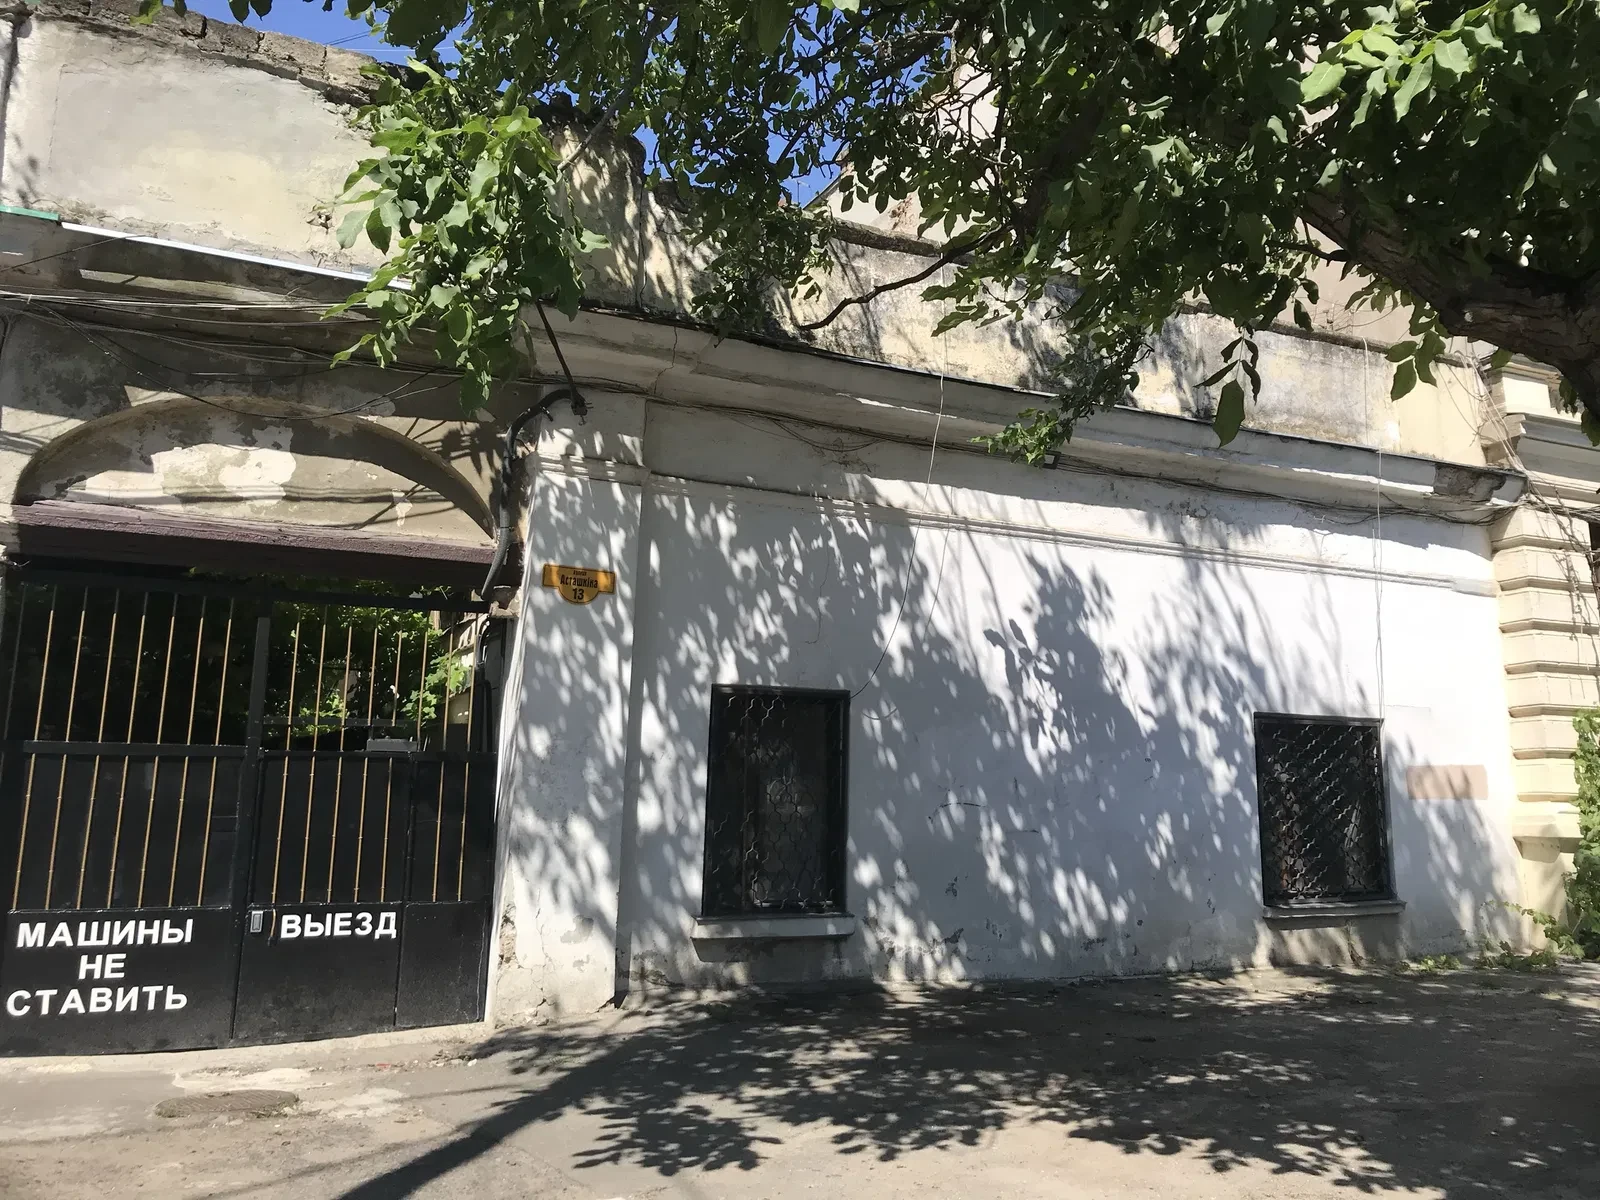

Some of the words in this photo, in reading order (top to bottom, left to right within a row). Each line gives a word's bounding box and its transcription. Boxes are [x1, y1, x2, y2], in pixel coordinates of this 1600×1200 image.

[560, 574, 598, 588] Асташкіна
[572, 589, 584, 600] 13
[16, 918, 193, 948] МАШИНЫ
[280, 911, 397, 939] ВЫЕЗД
[78, 953, 127, 980] НЕ
[6, 985, 188, 1016] СТАВИТЬ
